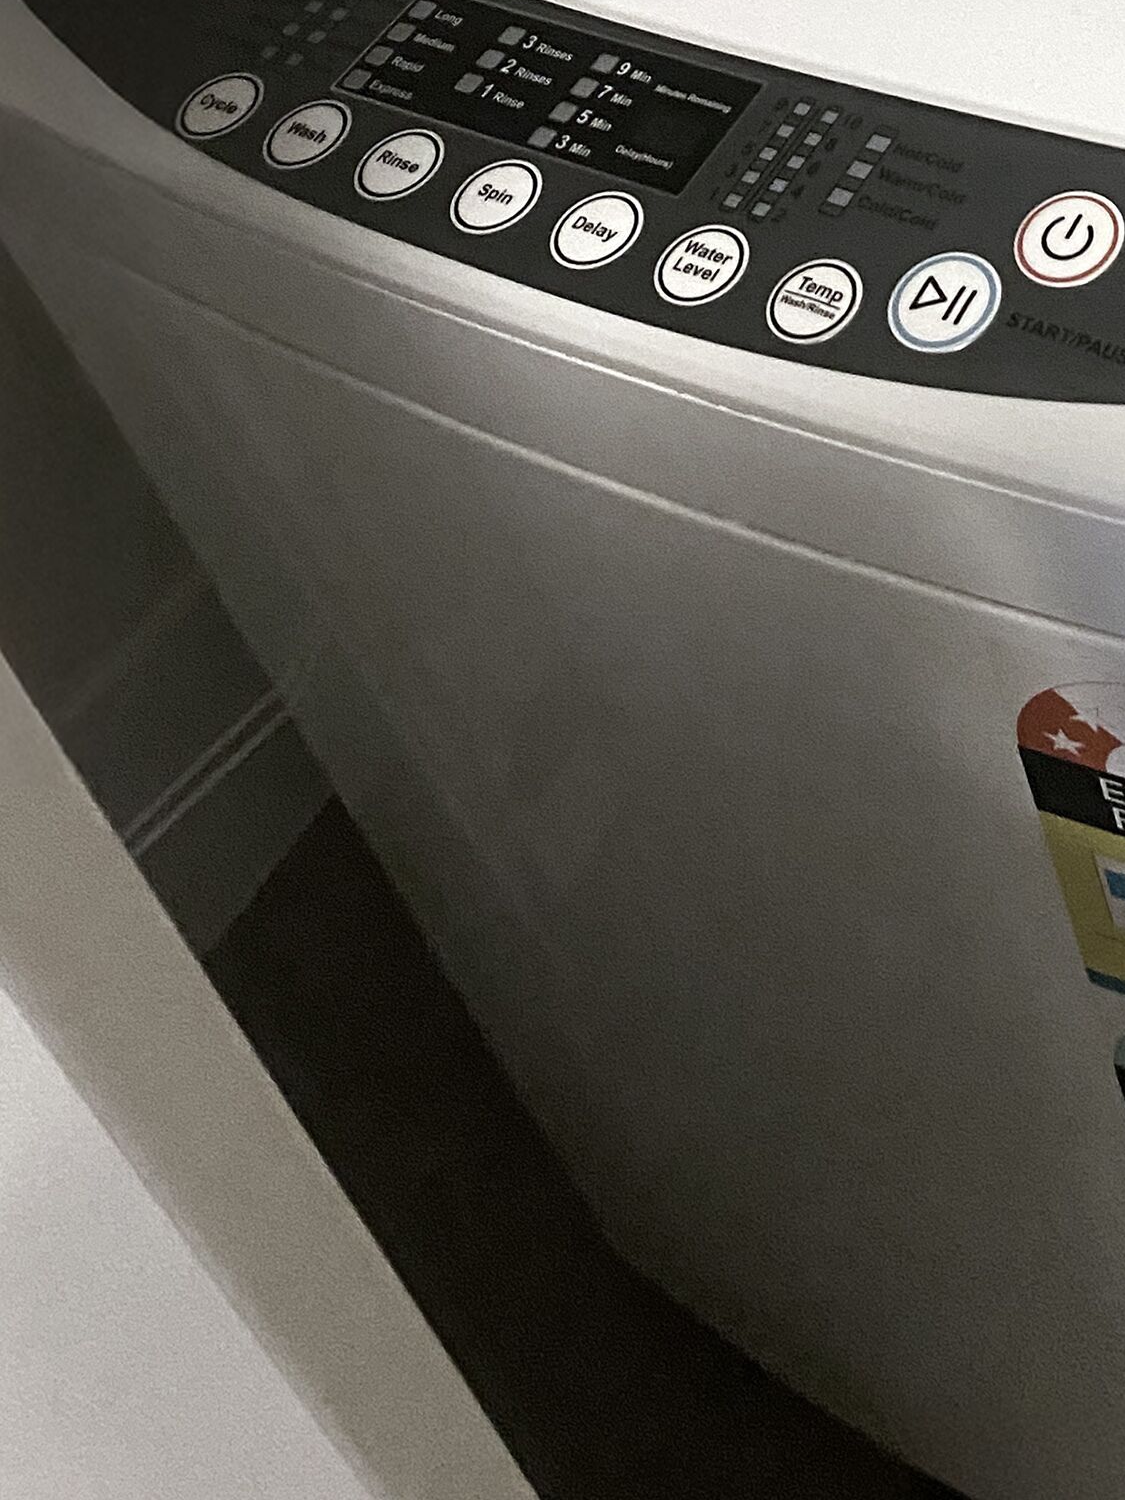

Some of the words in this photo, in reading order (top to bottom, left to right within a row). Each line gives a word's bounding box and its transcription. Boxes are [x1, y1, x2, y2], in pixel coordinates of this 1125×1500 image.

[434, 9, 464, 27] Long
[412, 32, 456, 52] Medium
[522, 35, 539, 50] 3
[535, 42, 574, 62] Rinses
[390, 55, 426, 74] Rapid
[500, 58, 518, 75] 2
[513, 66, 553, 86] Rinses
[616, 61, 632, 76] 9
[629, 69, 652, 84] Min
[368, 79, 414, 101] Express
[480, 83, 495, 99] 1
[492, 91, 526, 110] Rinse
[596, 84, 613, 99] 7
[609, 92, 633, 108] Min
[199, 93, 238, 114] Cycle
[575, 108, 593, 125] 5
[588, 116, 612, 132] Min
[286, 120, 327, 145] Wash
[555, 134, 571, 150] 3
[568, 142, 592, 157] Min
[376, 149, 420, 174] Rinse
[477, 183, 514, 206] Spin
[571, 215, 618, 243] Delay
[683, 239, 734, 266] Water
[672, 260, 722, 284] Level
[797, 275, 844, 305] Temp
[780, 293, 836, 321] Wash/Rinse
